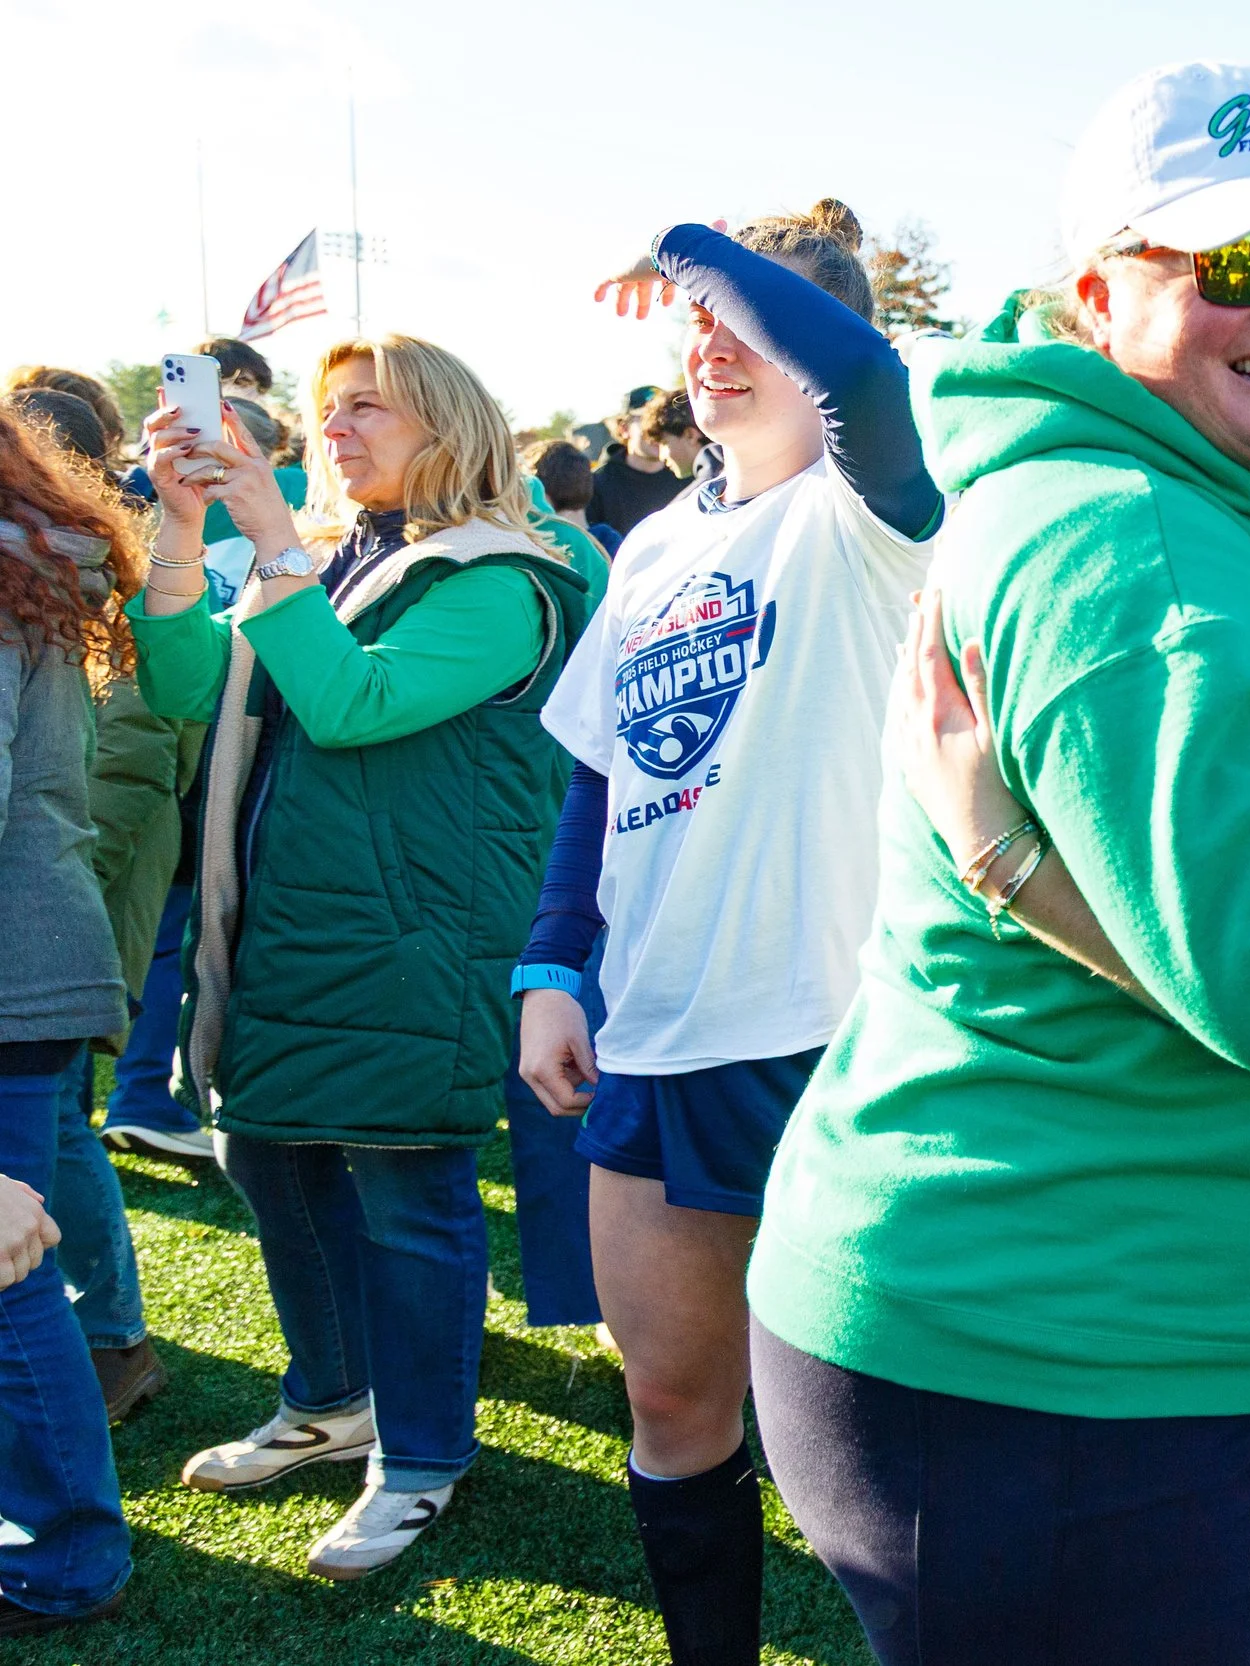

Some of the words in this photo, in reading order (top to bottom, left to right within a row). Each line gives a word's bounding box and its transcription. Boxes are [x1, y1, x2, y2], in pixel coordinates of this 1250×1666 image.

[617, 638, 761, 725] HAMPIO
[622, 666, 637, 684] 2025
[638, 654, 669, 675] FIELD
[672, 633, 723, 661] HOCKEY
